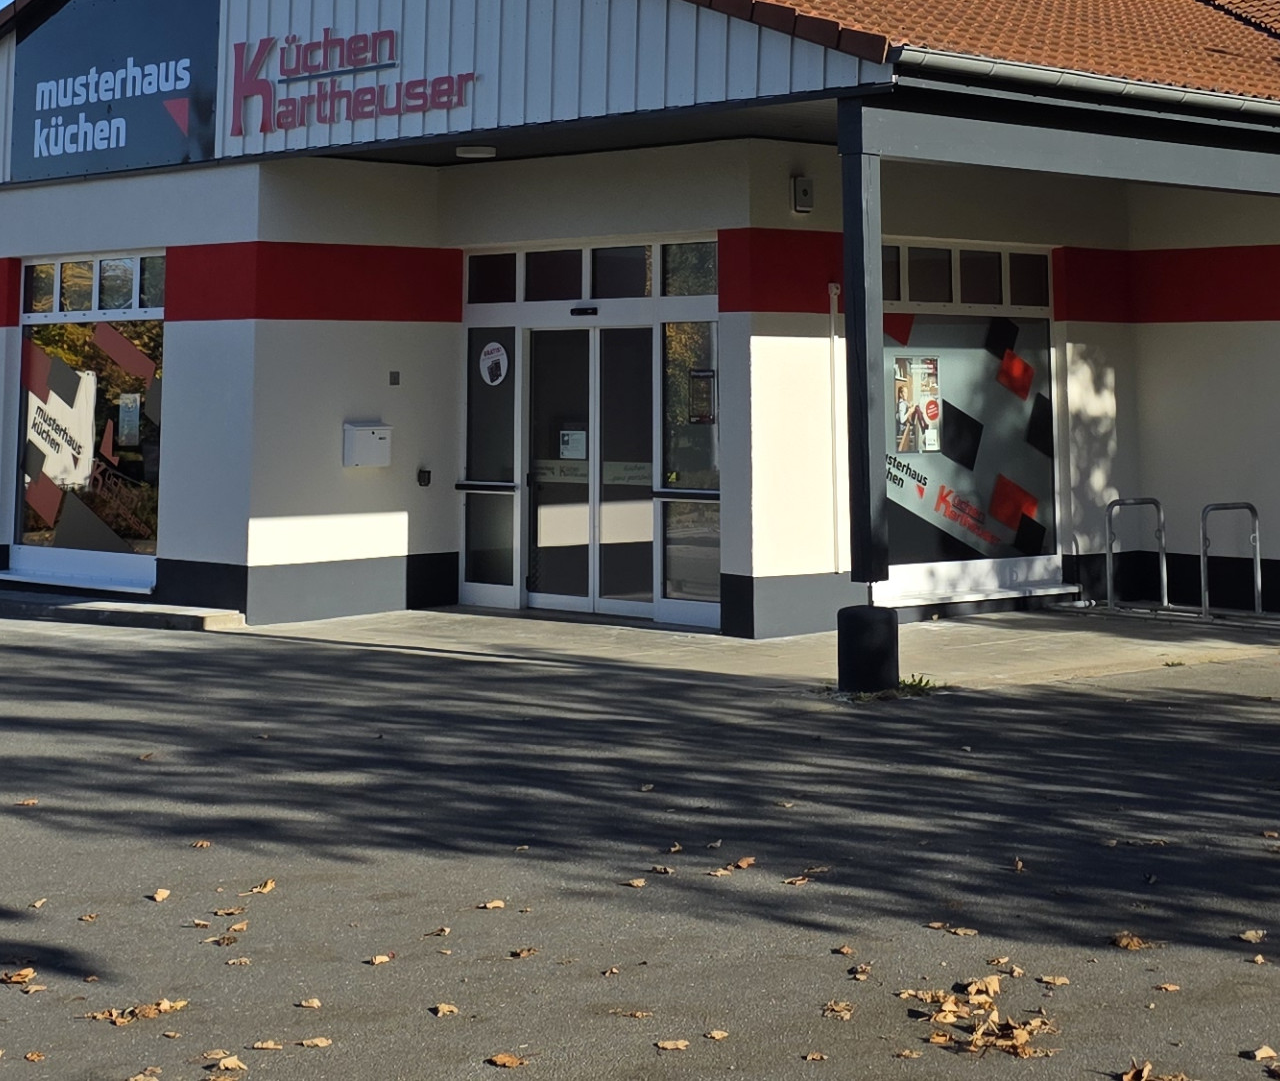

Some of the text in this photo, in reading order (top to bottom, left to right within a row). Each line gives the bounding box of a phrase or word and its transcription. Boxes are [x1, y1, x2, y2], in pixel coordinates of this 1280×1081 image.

[35, 57, 191, 111] musterhaus
[34, 113, 126, 158] küchen
[31, 417, 61, 454] küchen
[35, 405, 82, 456] musterhaus
[886, 453, 928, 486] sterhaus
